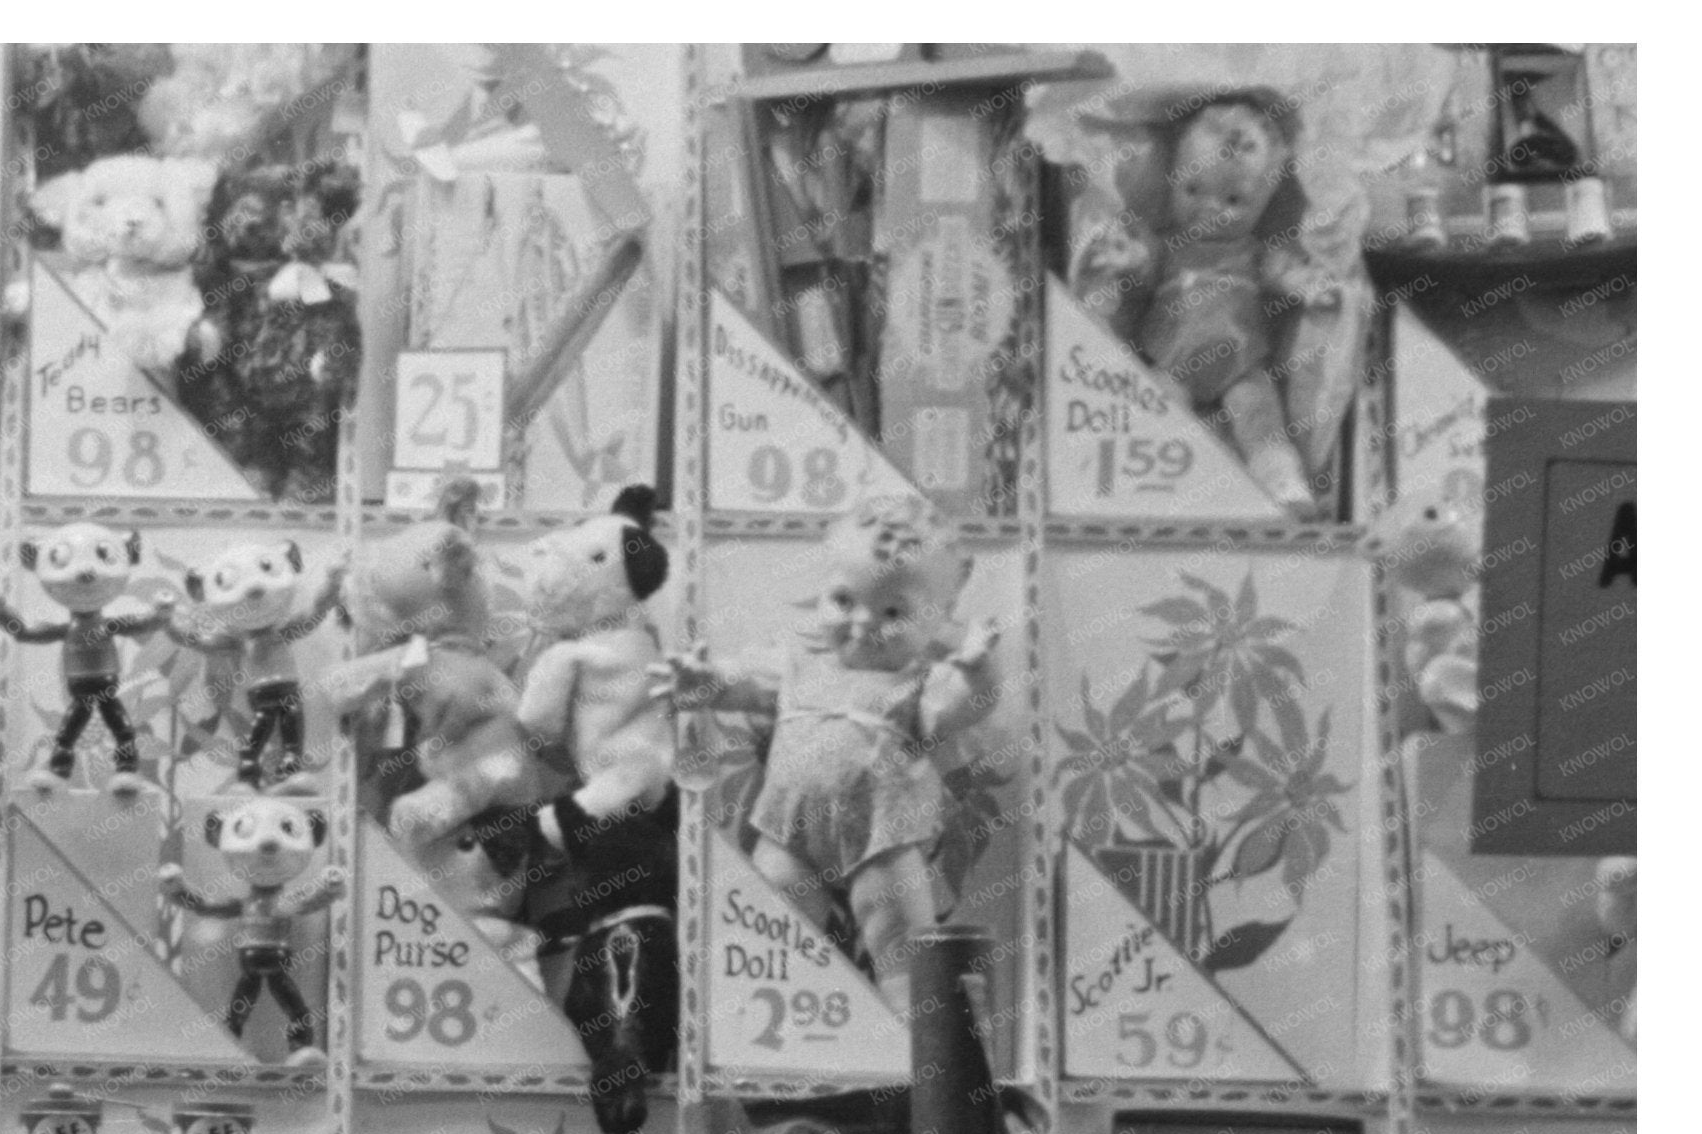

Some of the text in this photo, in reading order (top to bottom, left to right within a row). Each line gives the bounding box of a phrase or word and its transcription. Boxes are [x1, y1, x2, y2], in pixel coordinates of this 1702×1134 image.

[35, 331, 102, 399] Teddy
[66, 386, 163, 416] Bears
[718, 402, 770, 432] Gun
[1066, 399, 1130, 433] Doll
[24, 893, 107, 950] Pete
[376, 885, 443, 934] Dog
[722, 888, 833, 968] Scootles
[374, 930, 470, 968] Purse
[725, 943, 789, 981] Doll
[1070, 922, 1155, 1015] Scottie
[1427, 923, 1517, 974] Jeep
